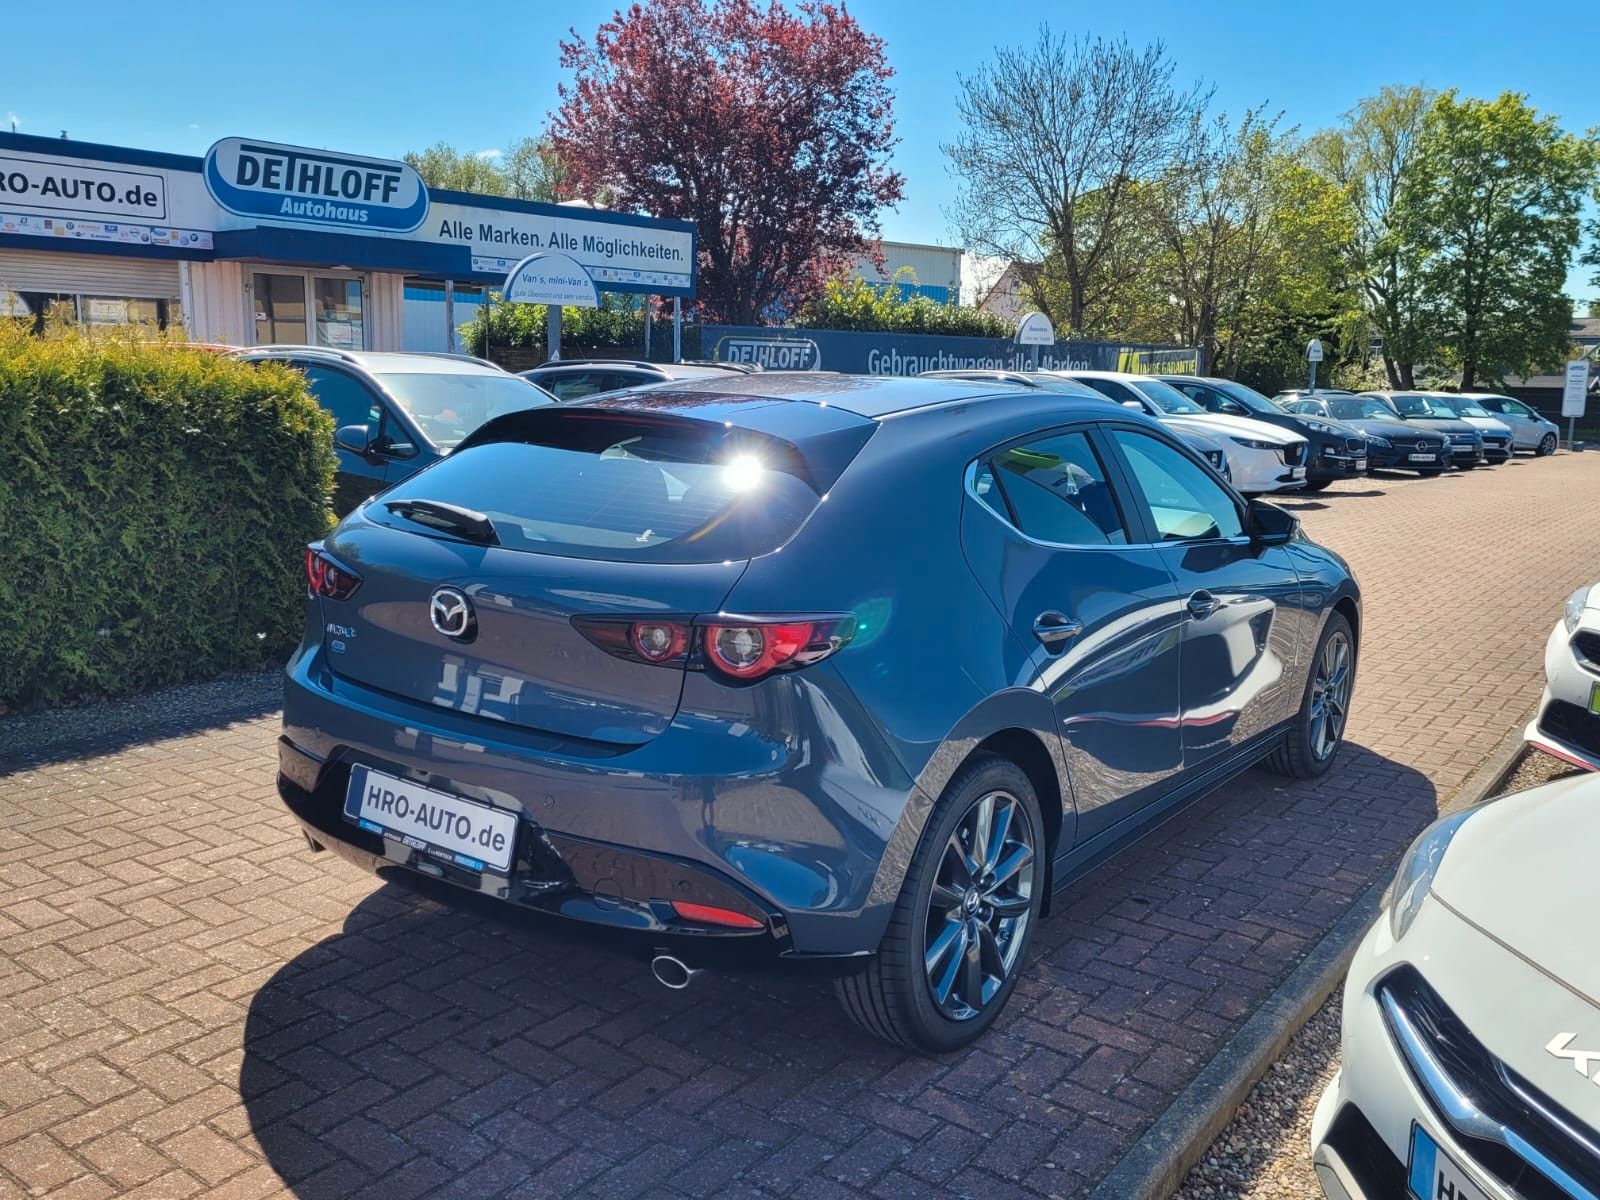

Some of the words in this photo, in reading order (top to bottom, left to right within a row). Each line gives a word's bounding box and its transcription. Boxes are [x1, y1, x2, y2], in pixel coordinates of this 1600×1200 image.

[236, 144, 402, 203] DETHLOFF
[280, 197, 368, 223] Autohaus
[439, 220, 473, 240] Alle
[479, 224, 545, 248] Marken.
[548, 232, 578, 251] Alle
[583, 234, 684, 262] Möglichkeiten.
[728, 340, 811, 369] DETHLOFF
[868, 347, 1003, 376] Gebrauchtwagen
[367, 784, 506, 852] HRO-AUTO.de
